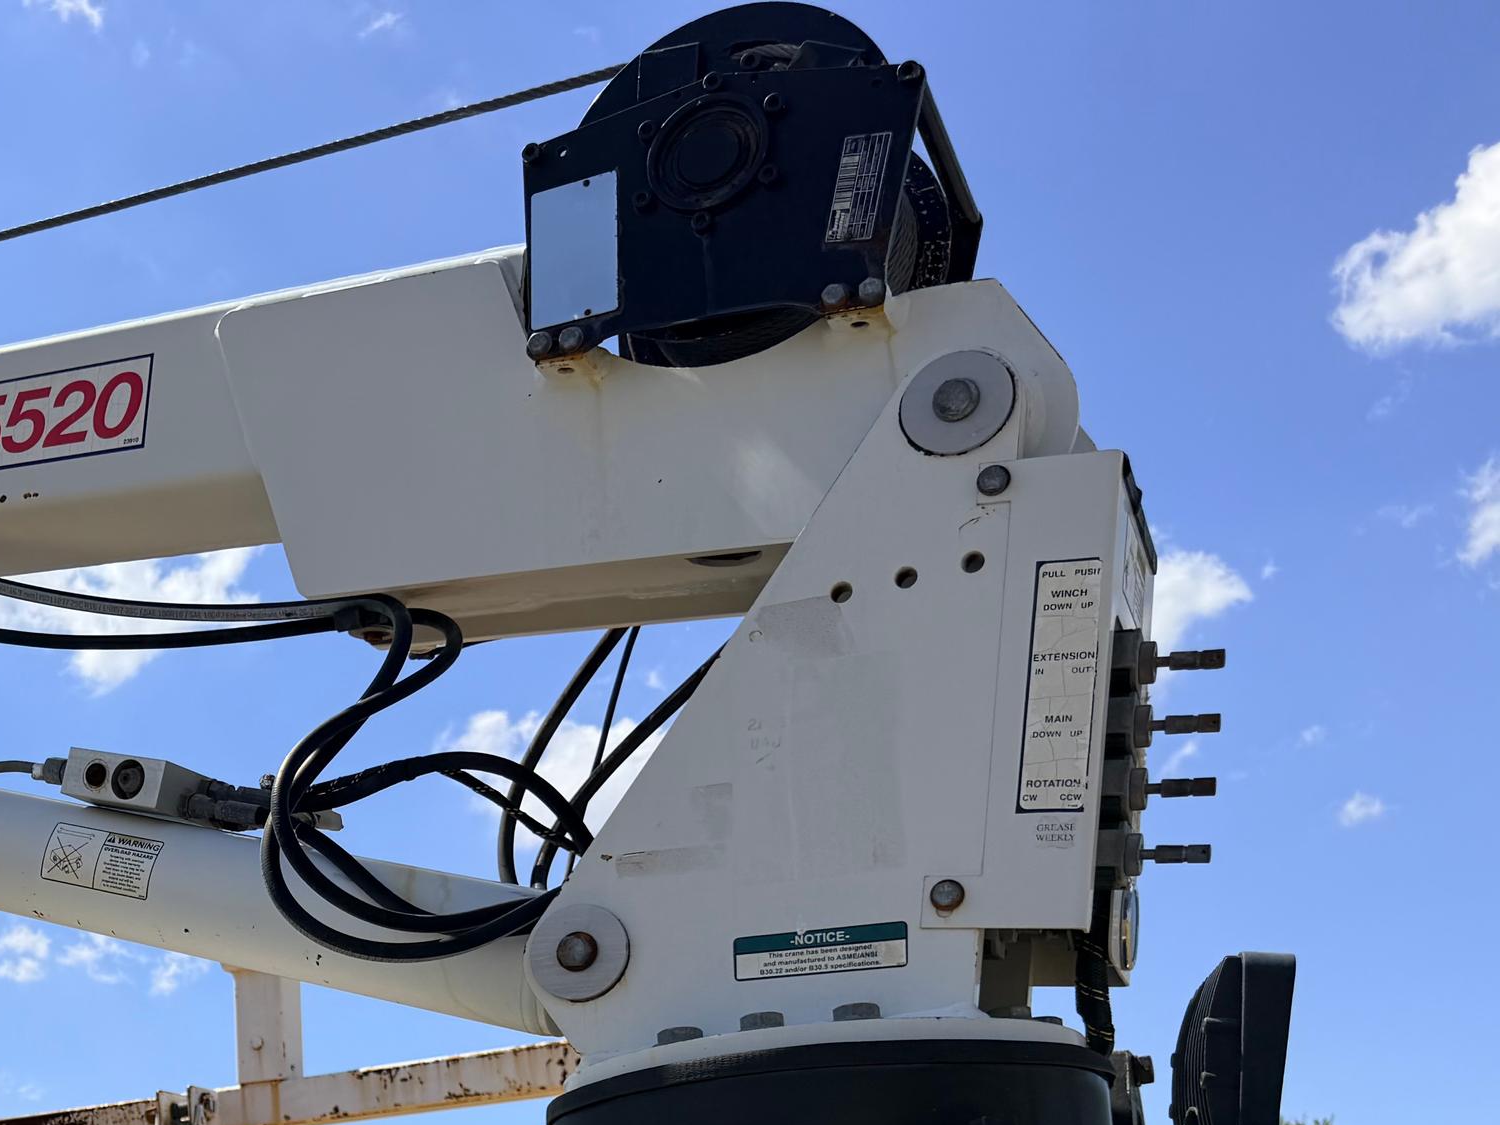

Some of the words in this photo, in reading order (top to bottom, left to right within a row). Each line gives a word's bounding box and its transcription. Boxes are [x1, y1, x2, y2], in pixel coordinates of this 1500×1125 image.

[1051, 589, 1087, 598] WINCH
[1044, 603, 1072, 611] DOWN
[1033, 652, 1095, 661] EXTENSION
[1045, 715, 1072, 723] MAIN
[1026, 779, 1081, 788] ROTATION
[118, 838, 160, 851] WARNING
[840, 944, 872, 952] designed
[778, 957, 825, 966] manufactured
[836, 951, 878, 960] ASME/ANSI
[831, 960, 882, 970] specifications.
